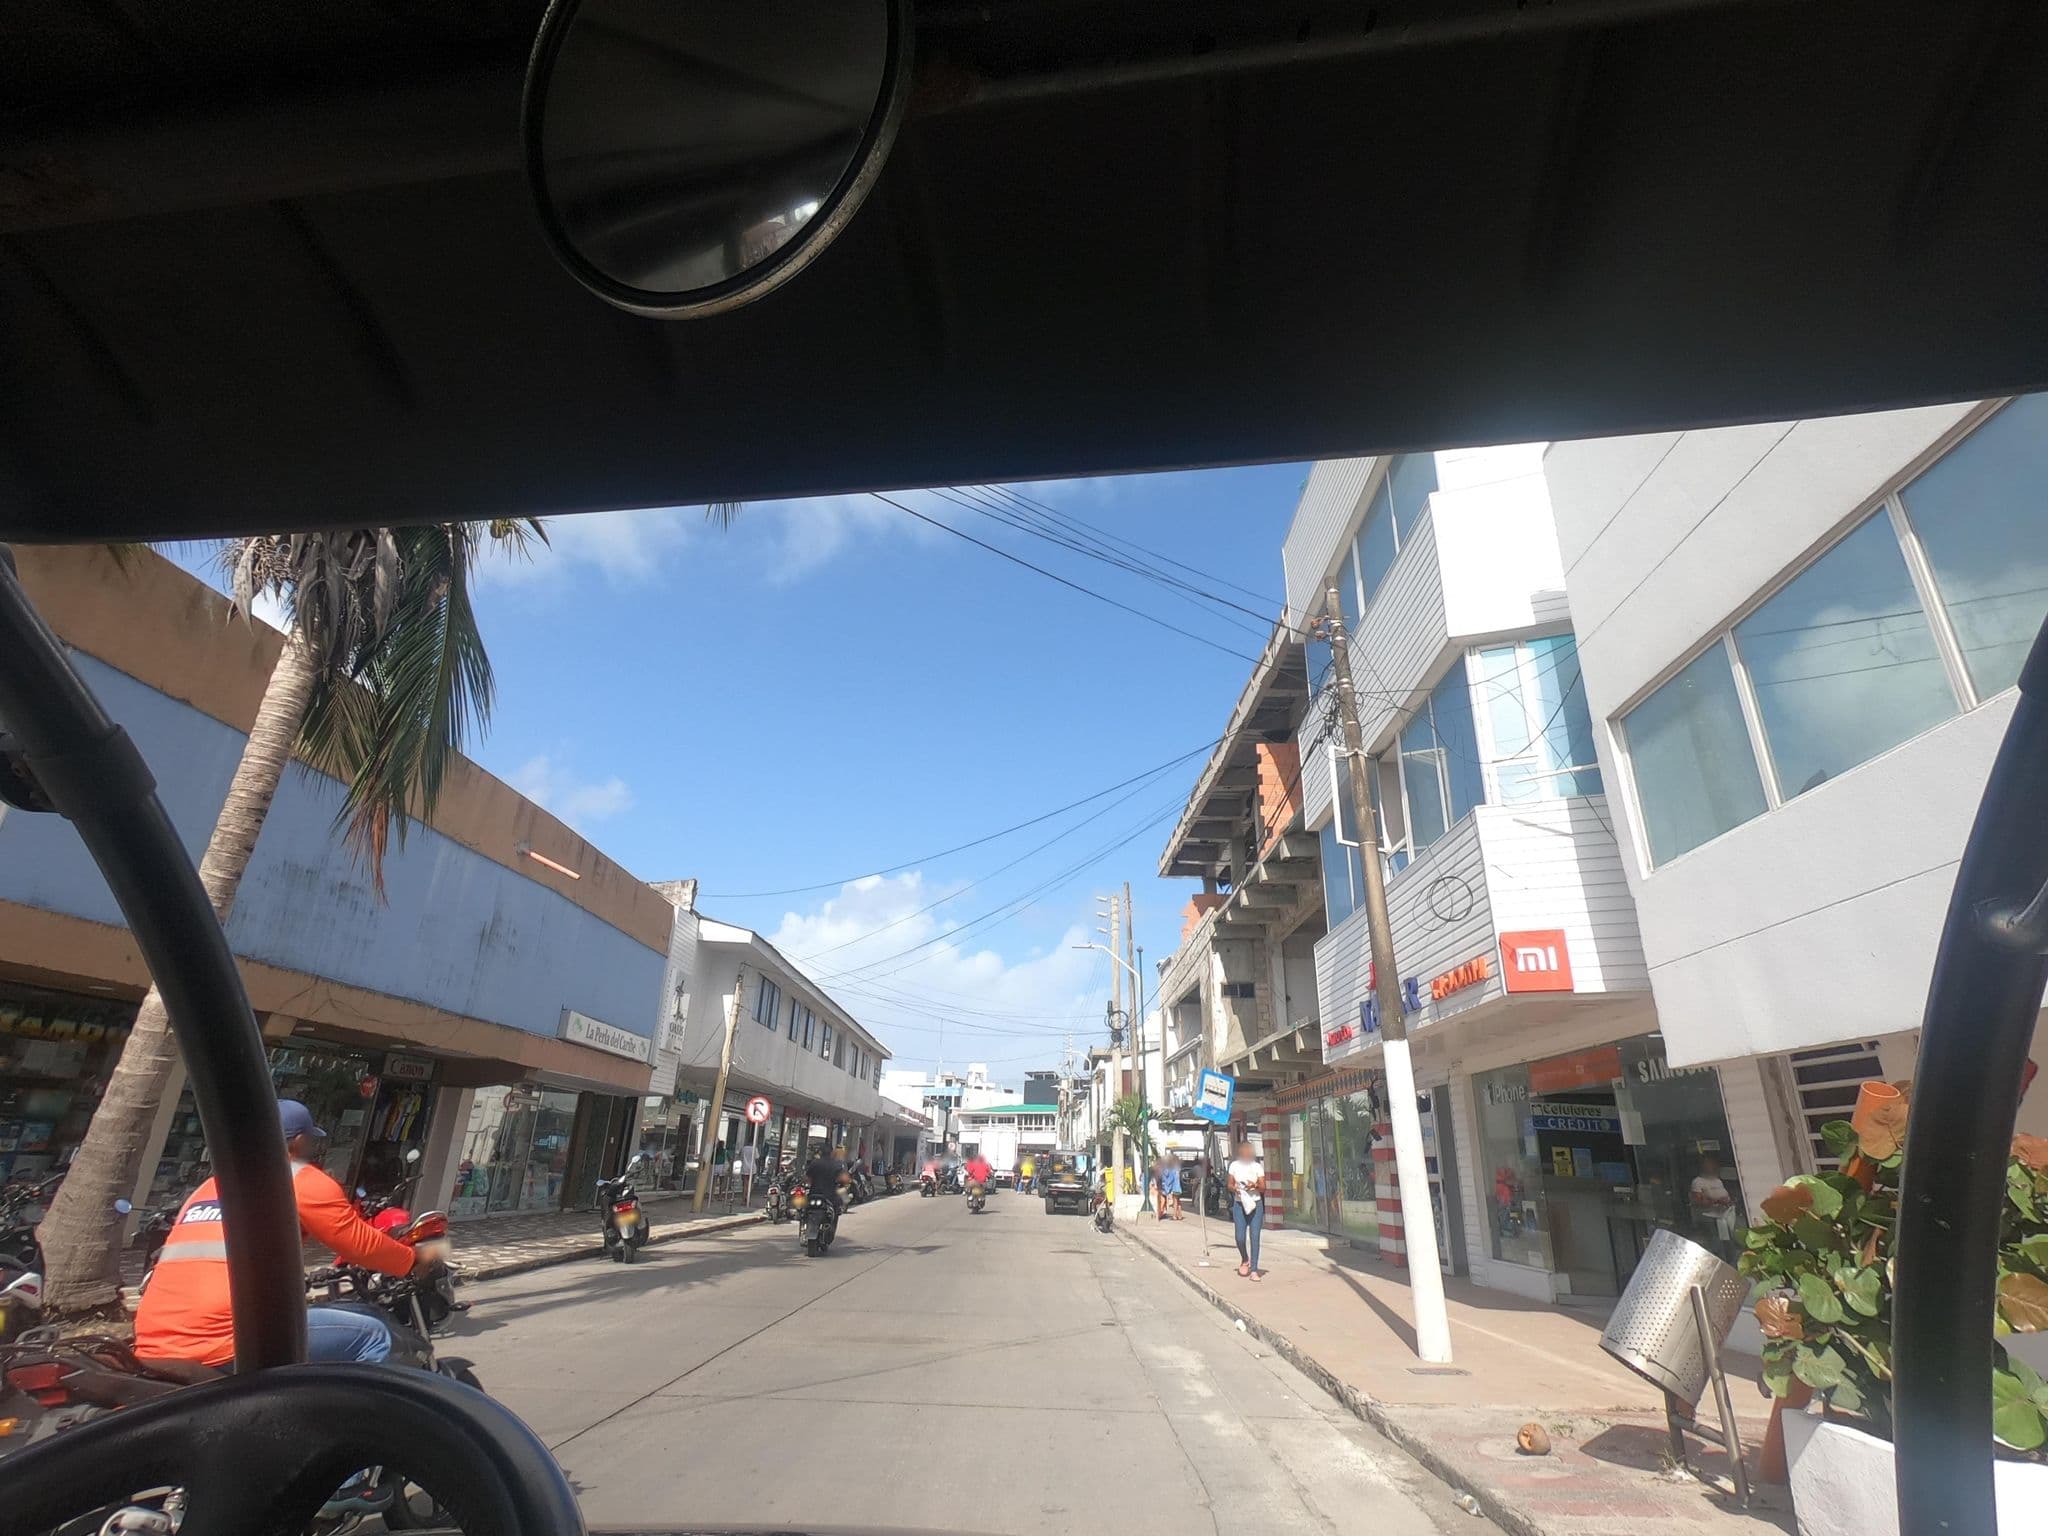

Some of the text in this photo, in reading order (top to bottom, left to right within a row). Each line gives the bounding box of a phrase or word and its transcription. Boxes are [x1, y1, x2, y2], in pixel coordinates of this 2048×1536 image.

[586, 1023, 595, 1039] La
[595, 1026, 610, 1045] Perla
[611, 1032, 620, 1049] del
